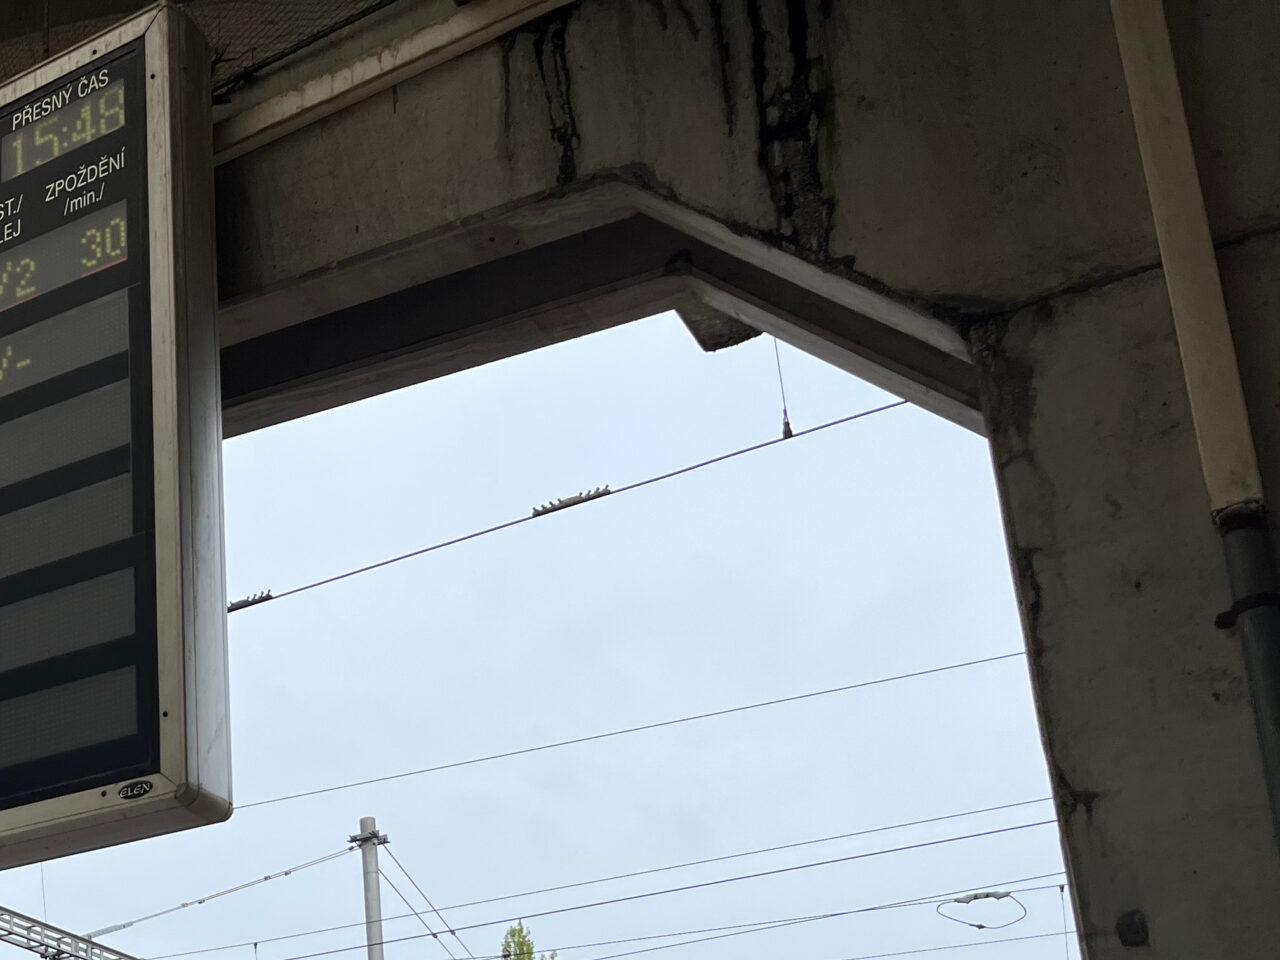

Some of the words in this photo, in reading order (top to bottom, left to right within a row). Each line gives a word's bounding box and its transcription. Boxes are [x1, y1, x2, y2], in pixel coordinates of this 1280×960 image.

[12, 86, 73, 131] PŘESNÝ
[77, 69, 111, 98] ČAS
[45, 147, 126, 202] ZPOŽDĚNÍ
[81, 217, 126, 268] 30
